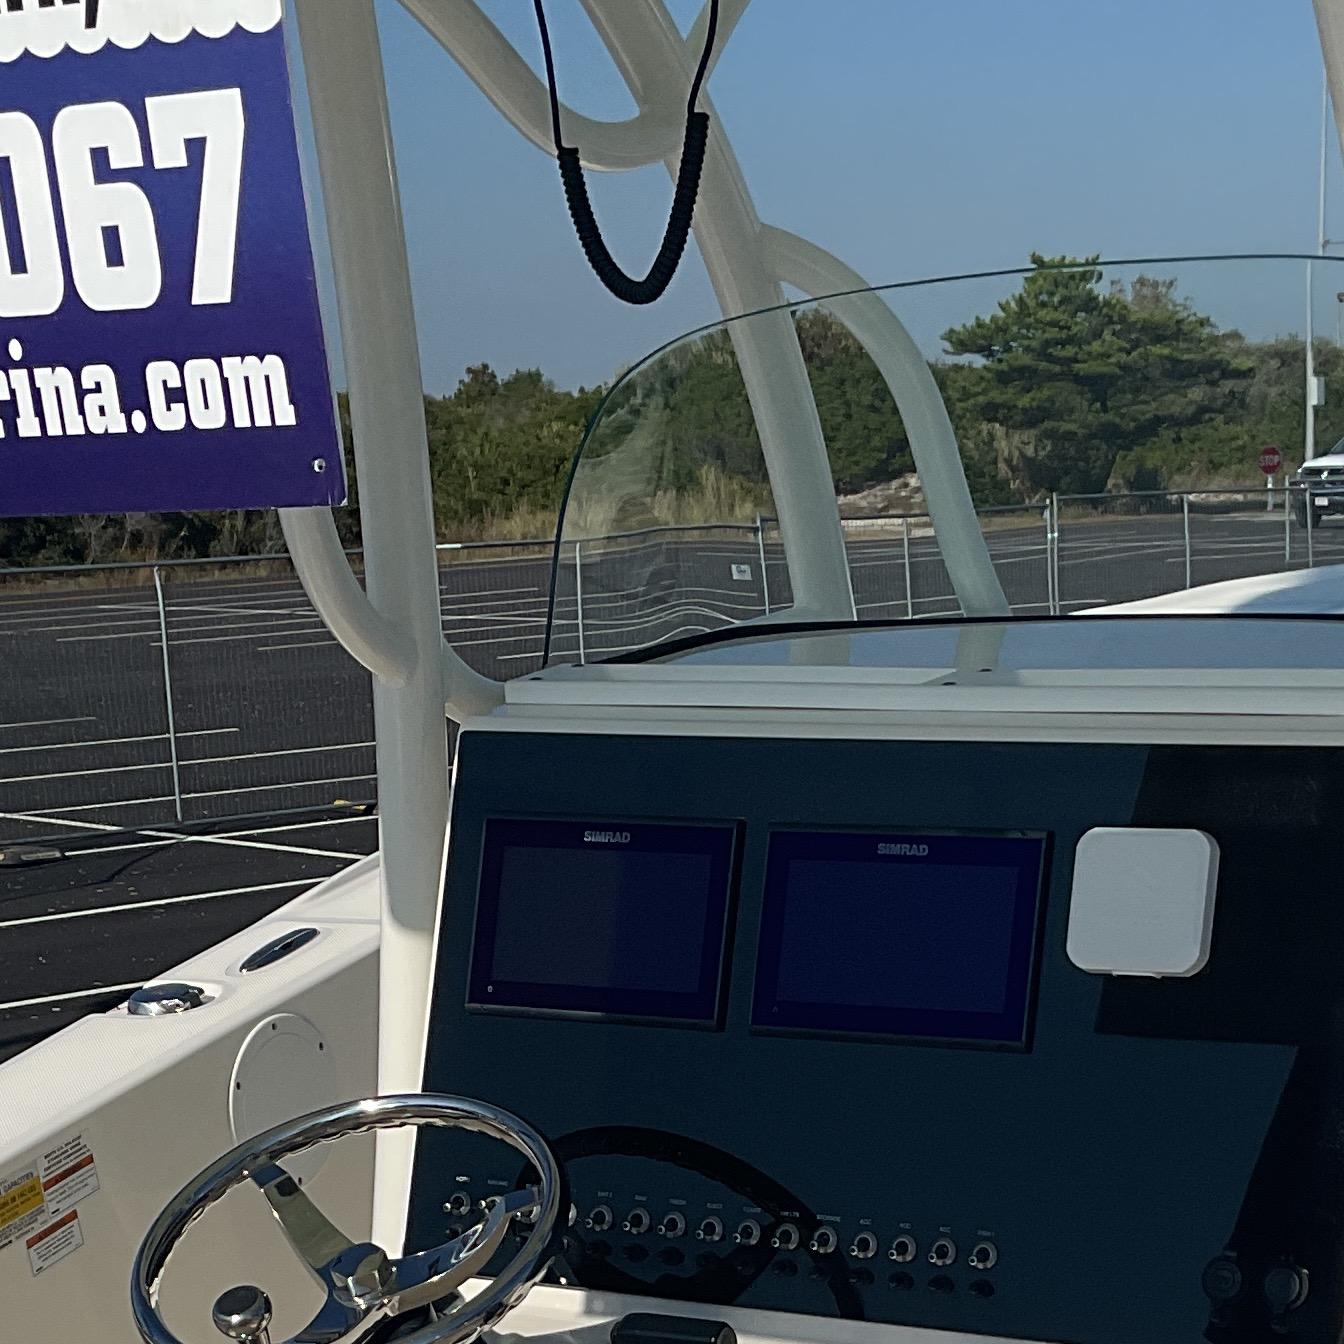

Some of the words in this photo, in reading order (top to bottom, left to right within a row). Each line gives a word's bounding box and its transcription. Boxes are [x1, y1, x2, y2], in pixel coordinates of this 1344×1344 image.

[1258, 454, 1280, 466] STOP
[584, 830, 631, 843] SIMRAD
[876, 843, 929, 856] SIMRAD
